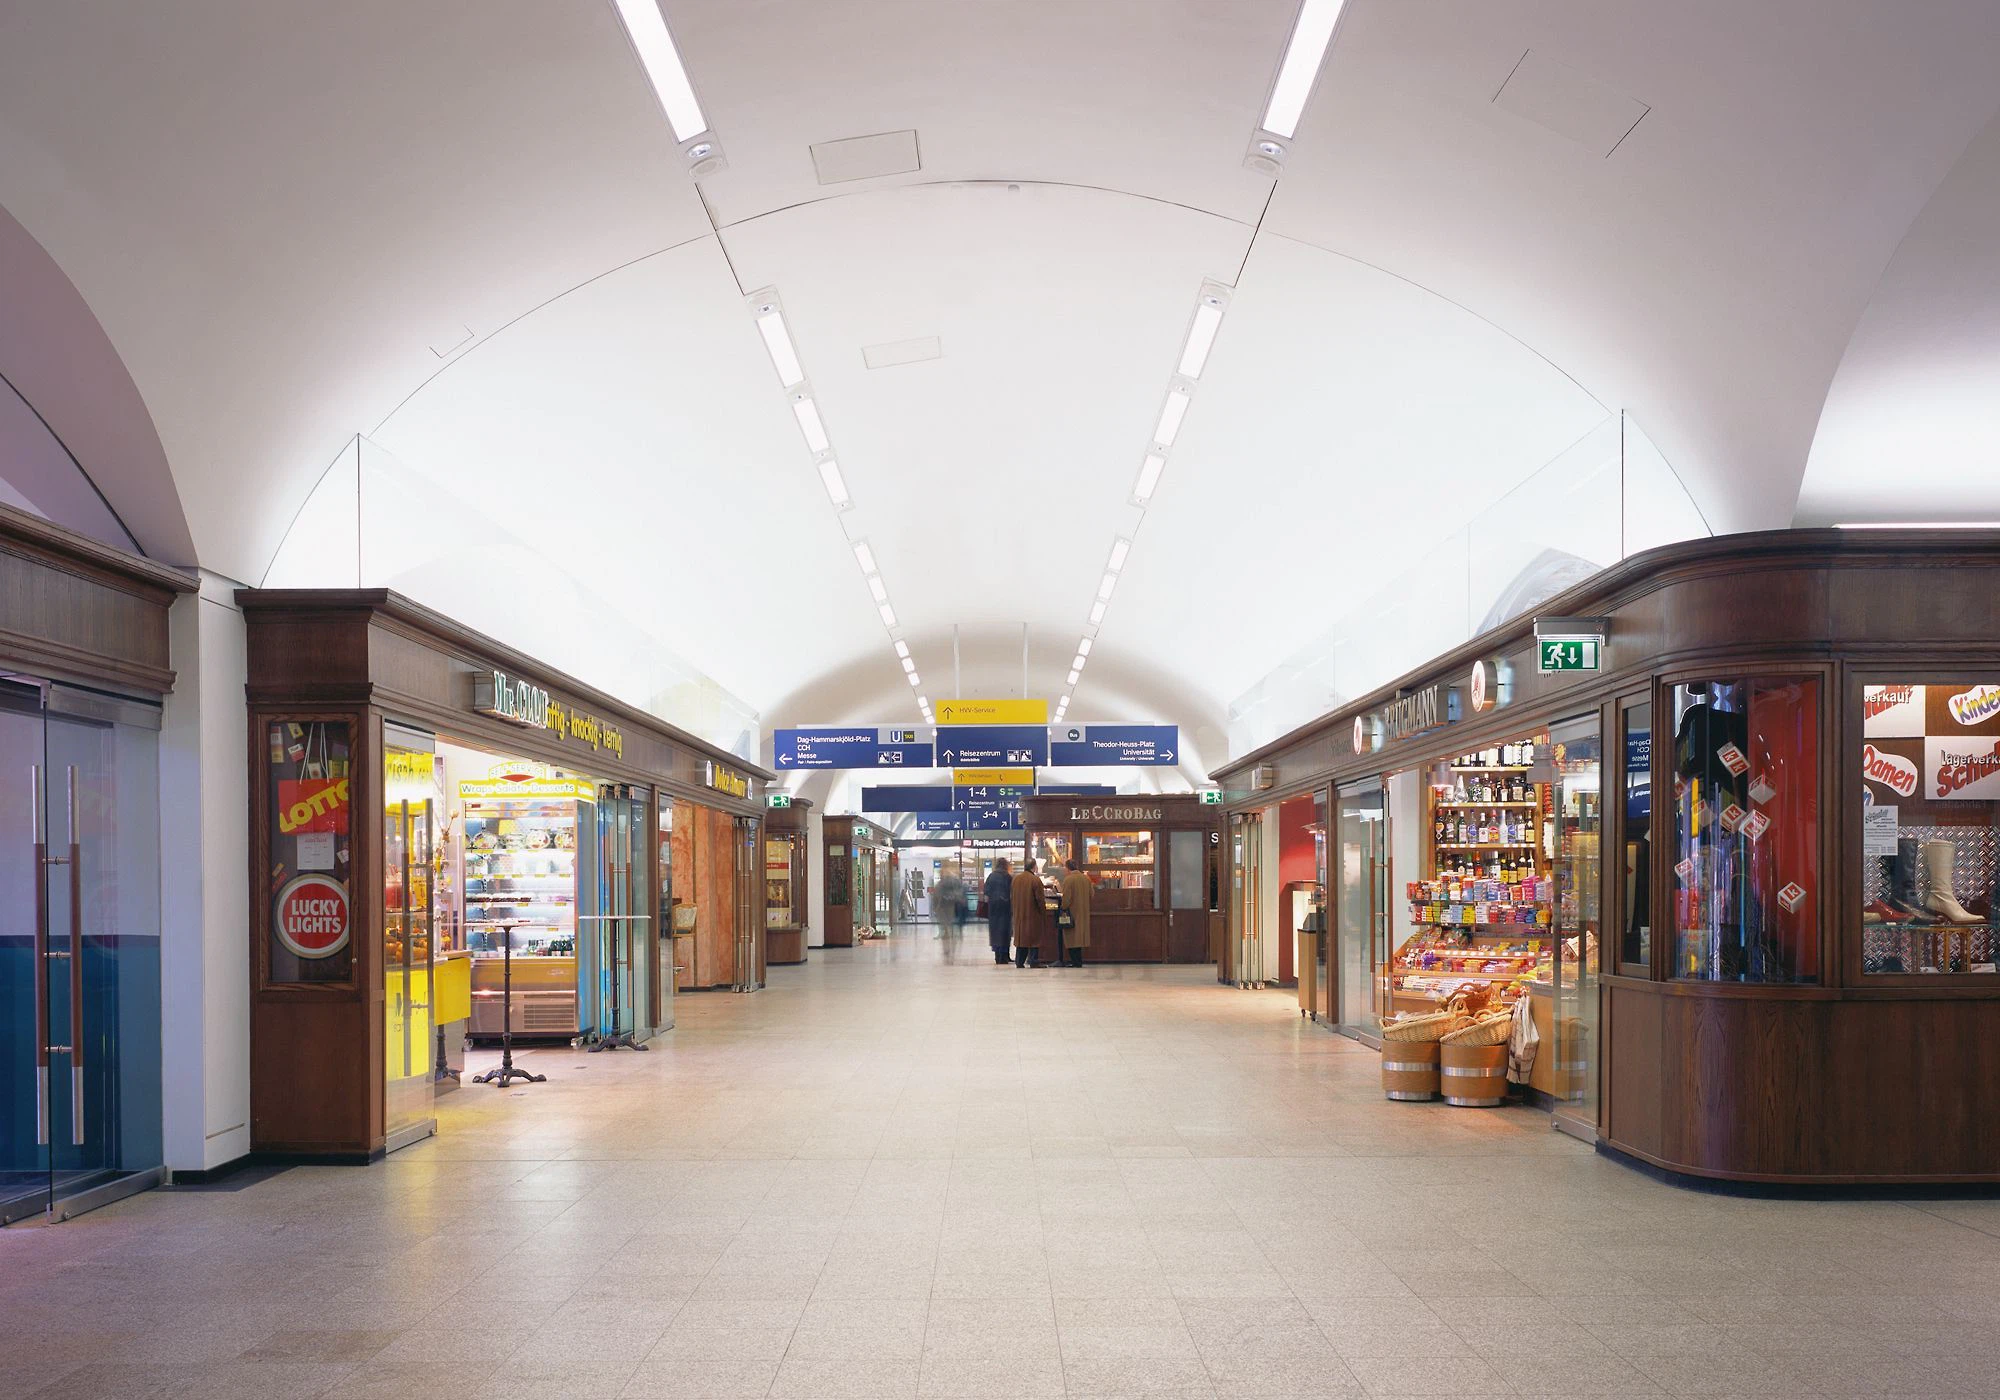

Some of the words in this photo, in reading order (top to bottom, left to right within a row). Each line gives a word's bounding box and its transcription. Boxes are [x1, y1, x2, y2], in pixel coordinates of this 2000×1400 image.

[797, 736, 870, 744] Dag-Hammarskjöld-Platz
[1940, 750, 2000, 768] Lagerverk
[1864, 746, 1914, 792] Damen
[968, 787, 987, 797] 1-4
[291, 900, 340, 916] LUCKY
[288, 916, 342, 933] LIGHTS
